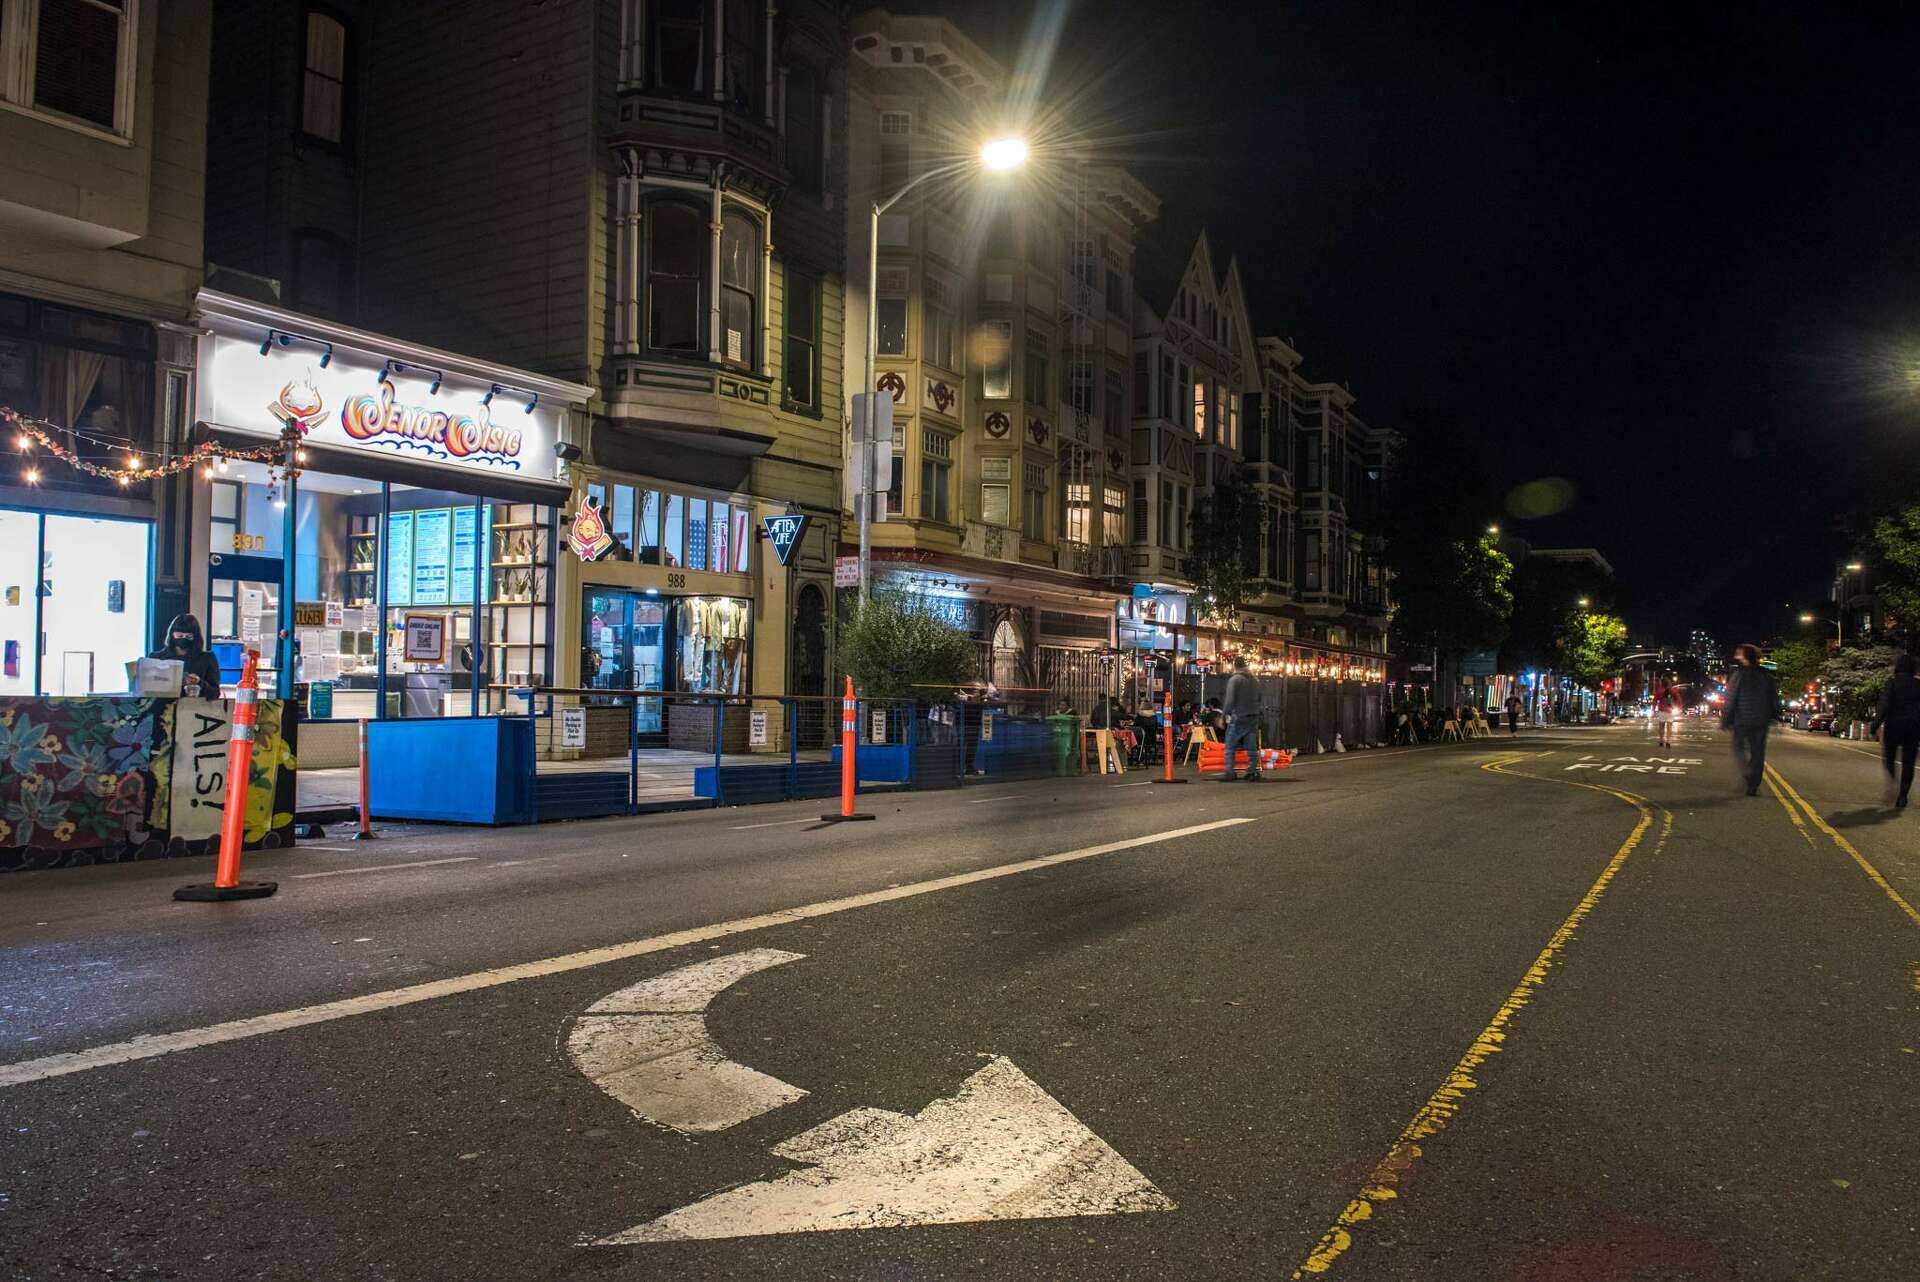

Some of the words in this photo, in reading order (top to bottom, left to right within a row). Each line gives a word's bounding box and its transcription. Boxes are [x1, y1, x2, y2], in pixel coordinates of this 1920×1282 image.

[445, 403, 522, 457] SISIG
[770, 519, 796, 532] AFTER
[775, 532, 791, 545] LIFE
[667, 573, 686, 588] 988
[1578, 755, 1703, 765] LANE
[1563, 763, 1689, 775] FIRE
